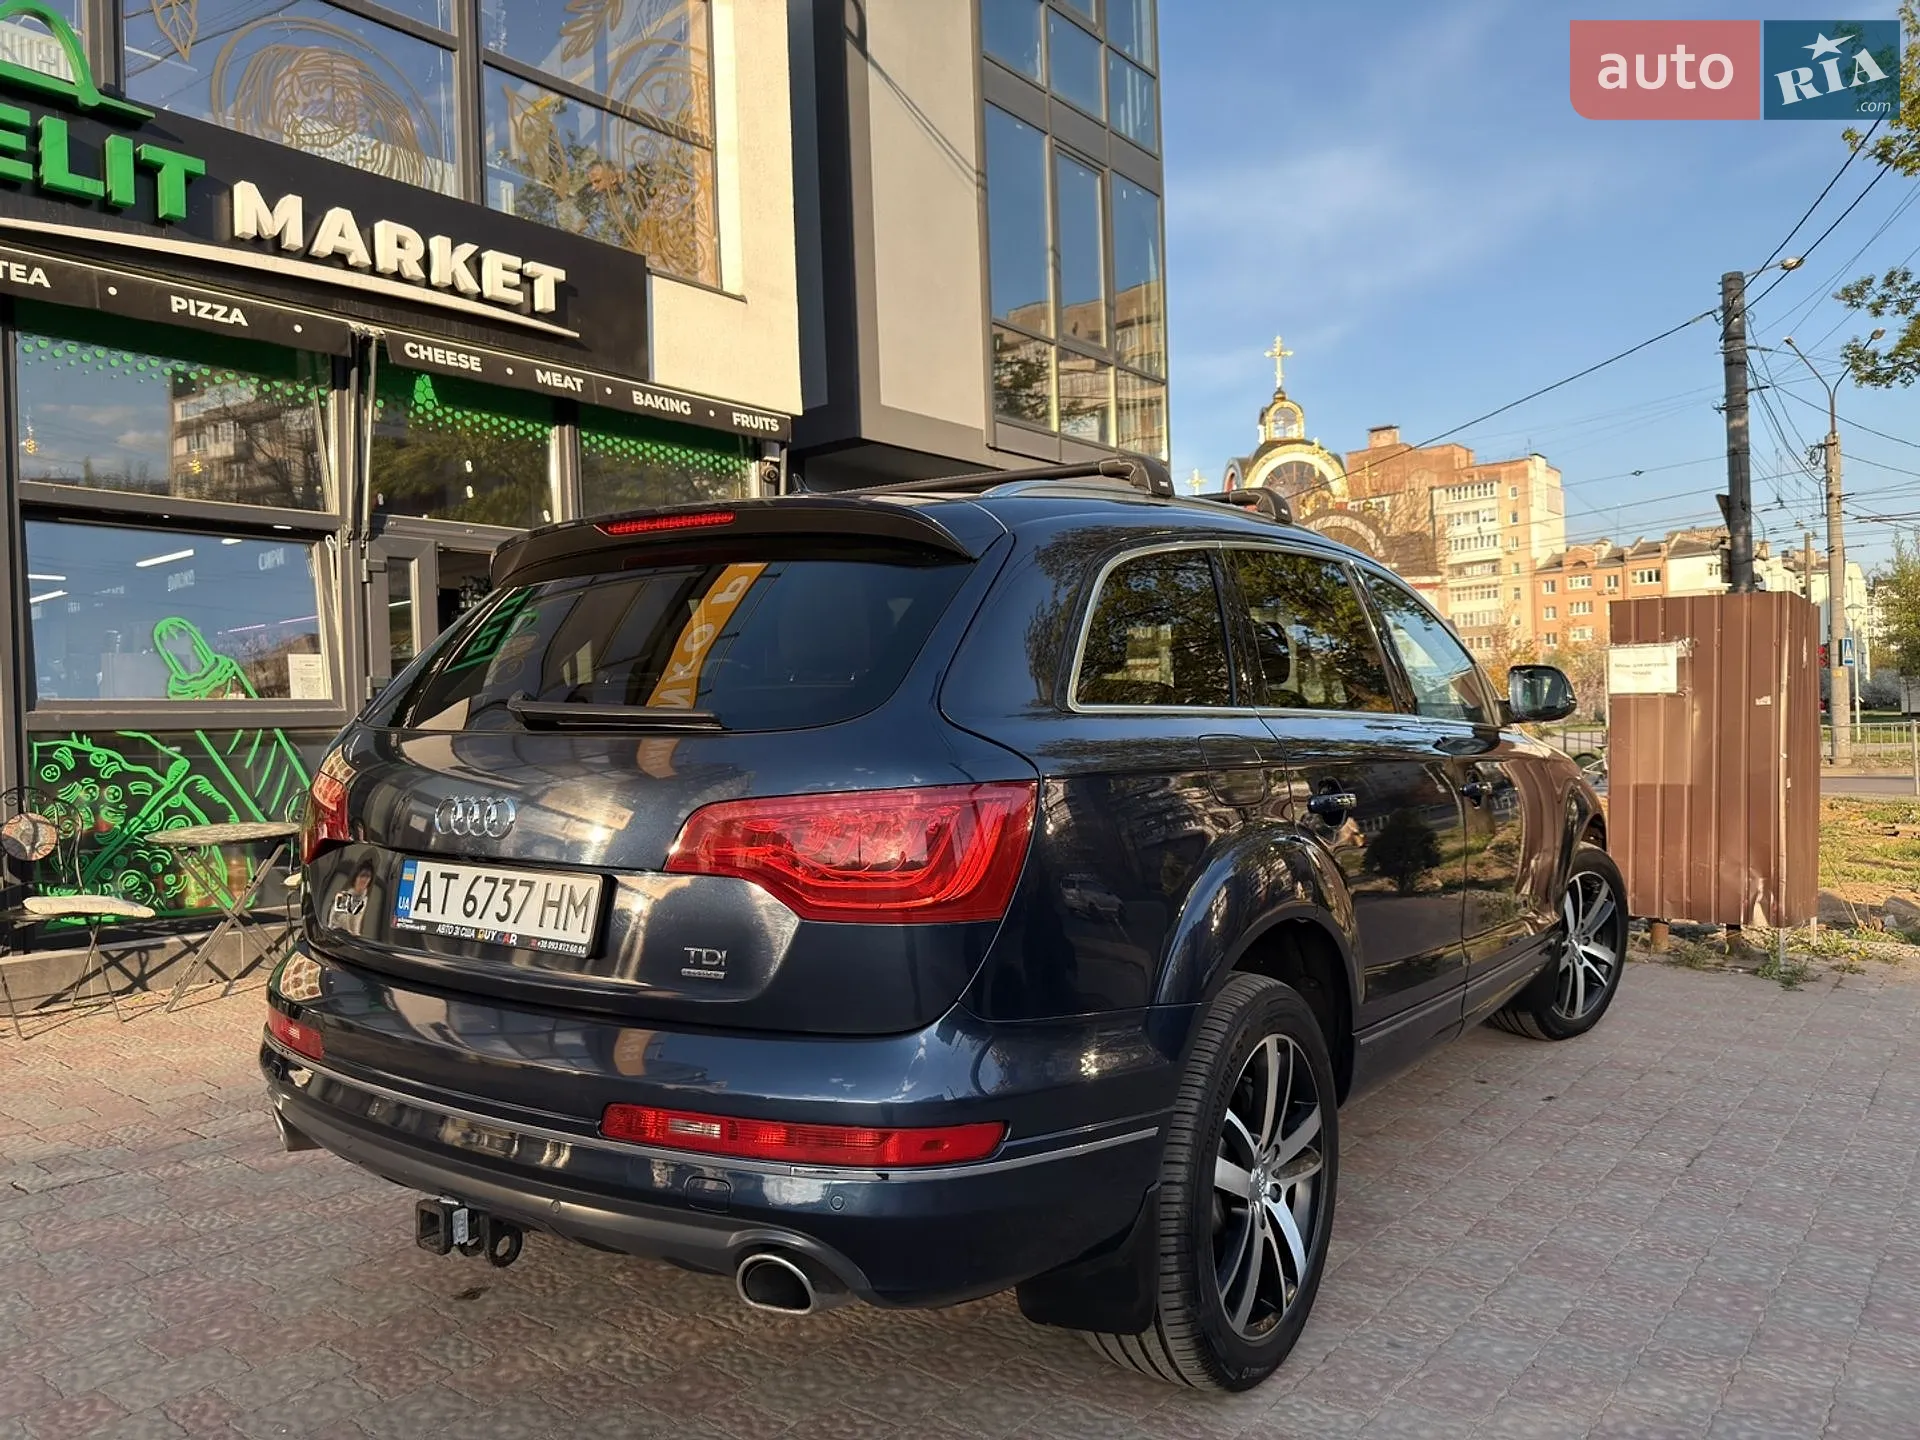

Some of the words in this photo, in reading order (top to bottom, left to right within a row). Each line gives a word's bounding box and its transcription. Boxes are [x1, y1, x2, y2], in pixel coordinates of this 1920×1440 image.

[232, 180, 567, 315] MARKET
[170, 295, 249, 327] PIZZA
[404, 341, 483, 373] CHEESE
[535, 368, 584, 393] MEAT
[632, 390, 692, 416] BAKING
[732, 411, 780, 433] FRUITS
[398, 896, 410, 911] UA
[413, 870, 460, 915] AT
[462, 875, 536, 924] 6737
[538, 883, 595, 934] HM
[683, 946, 728, 967] TDI
